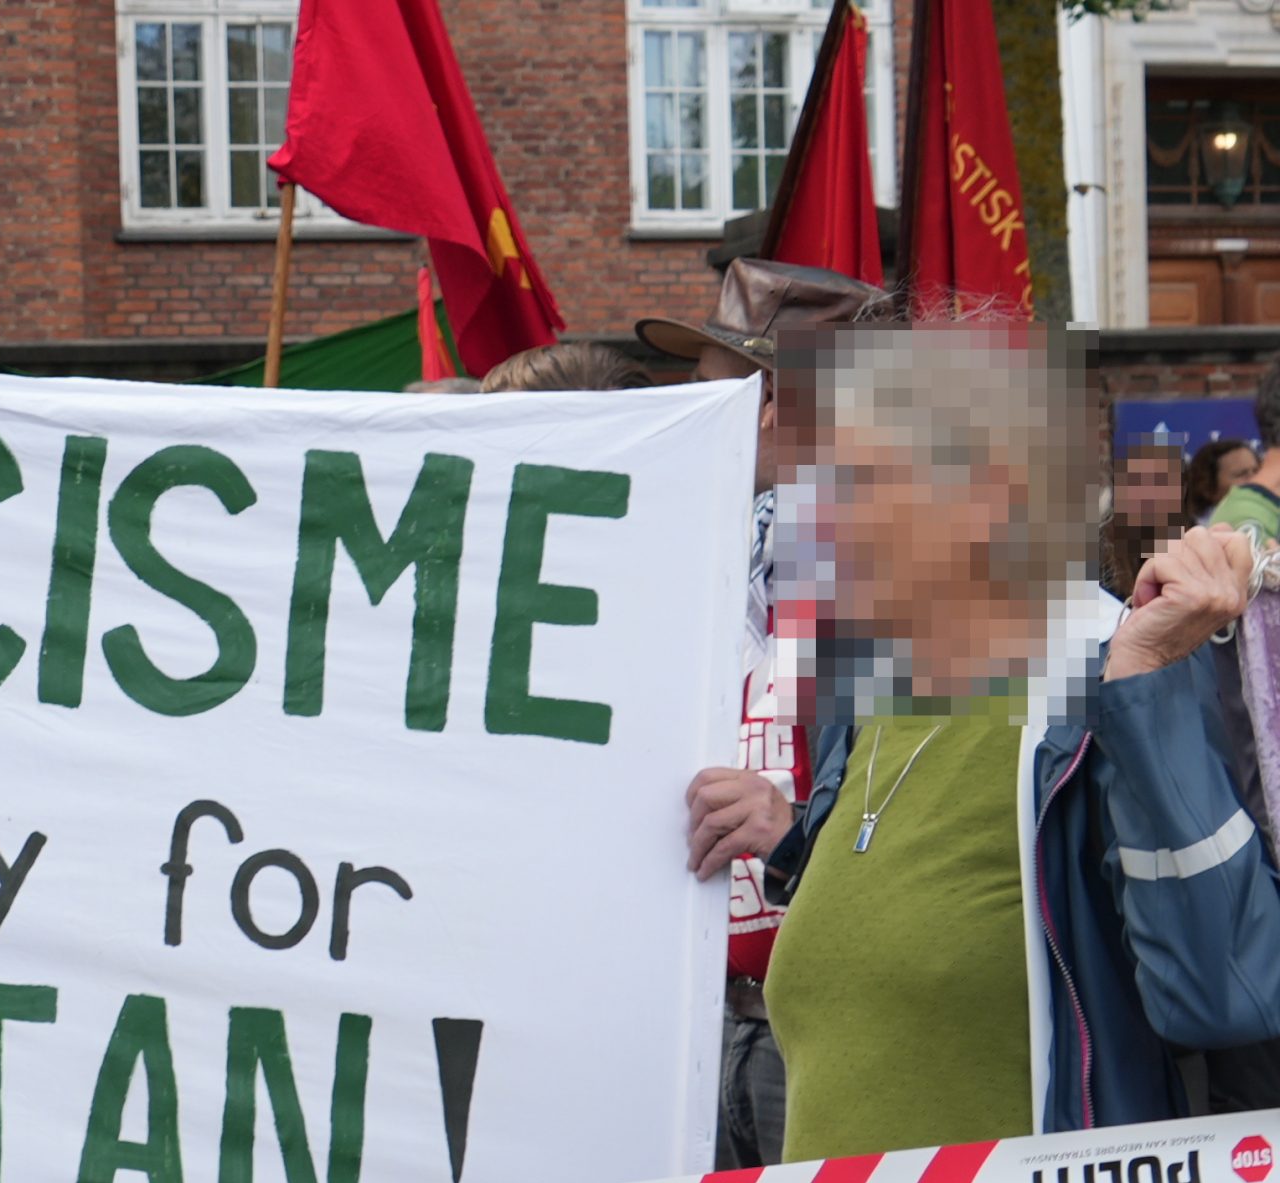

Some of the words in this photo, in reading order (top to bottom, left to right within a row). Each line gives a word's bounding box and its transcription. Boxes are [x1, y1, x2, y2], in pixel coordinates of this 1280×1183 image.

[951, 133, 1024, 250] STISK
[160, 800, 412, 960] for
[1095, 1141, 1141, 1156] MEDFØRE
[1142, 1139, 1168, 1150] KAN
[1170, 1133, 1216, 1147] PASSAGE
[1021, 1148, 1092, 1165] STRAFANSVA
[1232, 1148, 1271, 1169] STOP
